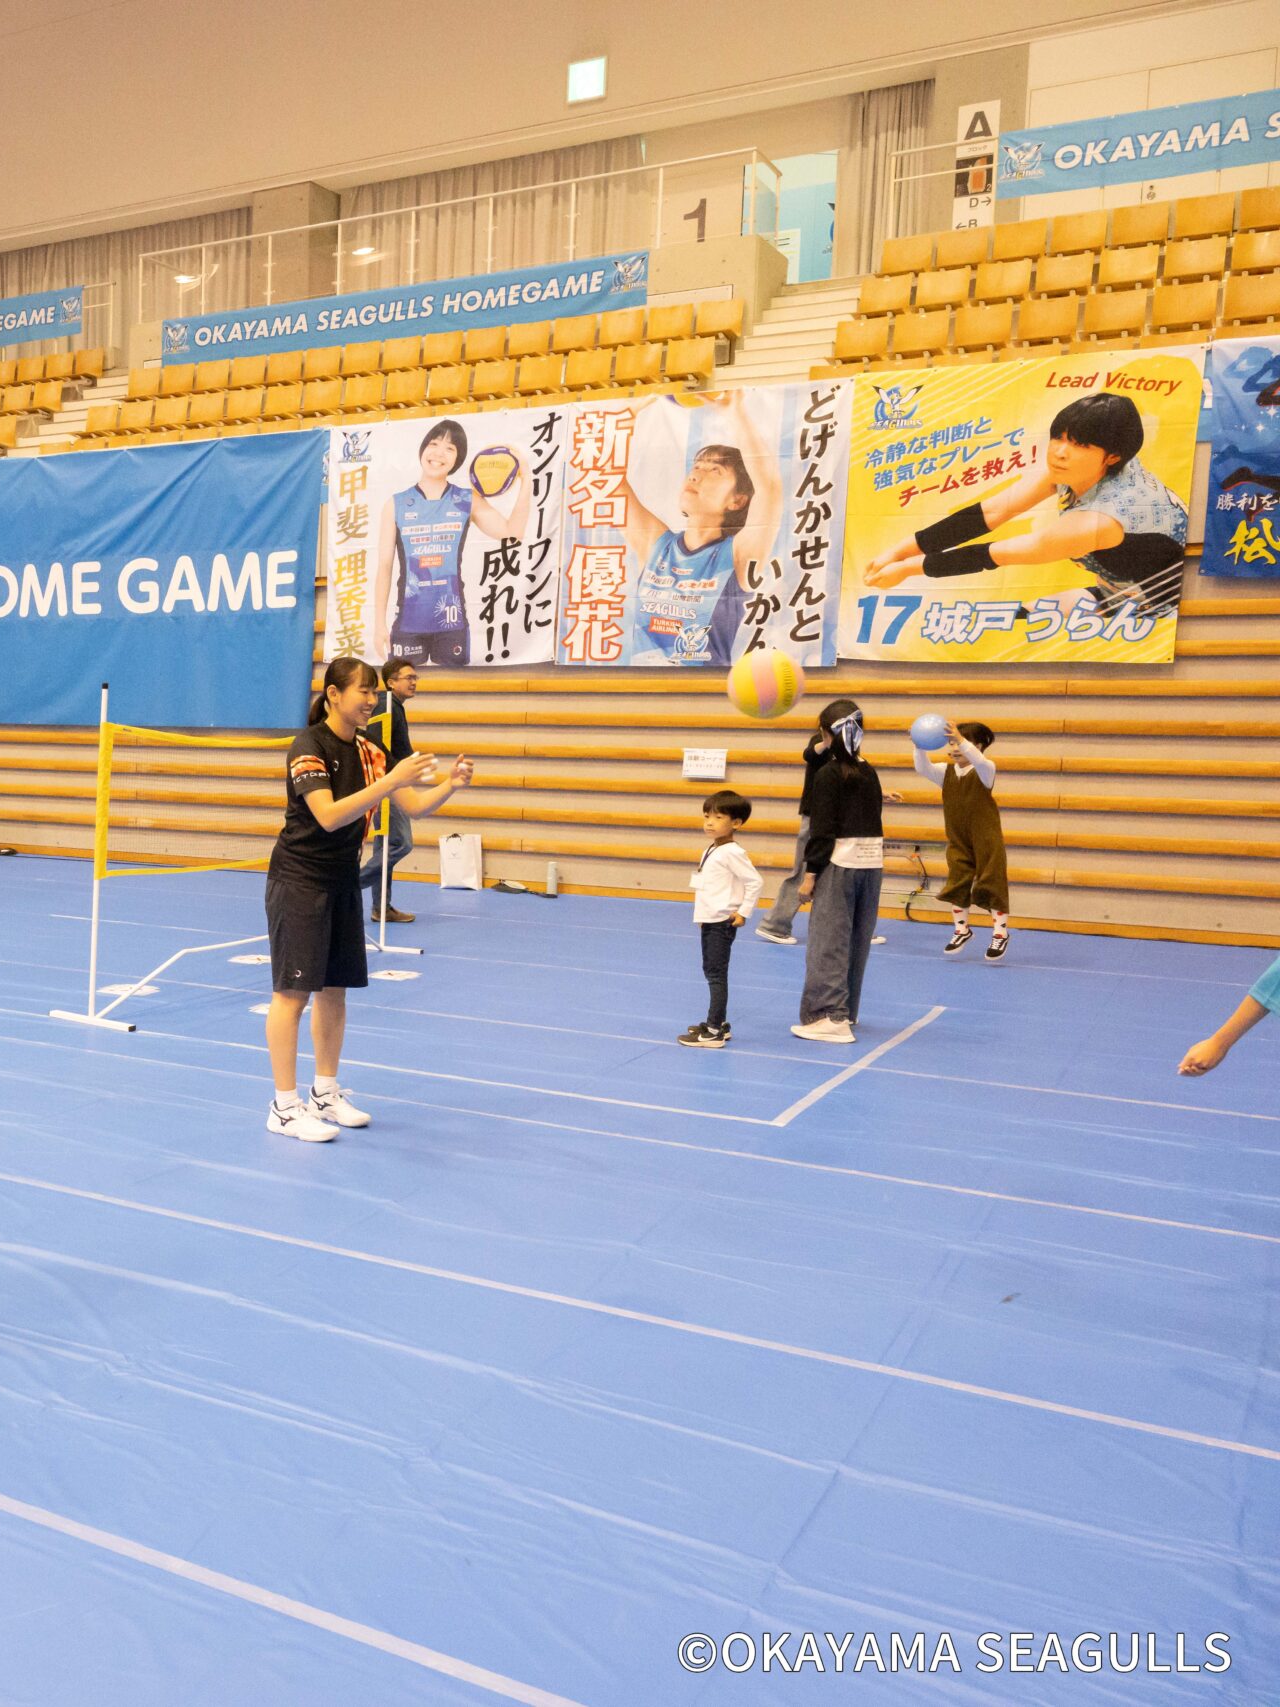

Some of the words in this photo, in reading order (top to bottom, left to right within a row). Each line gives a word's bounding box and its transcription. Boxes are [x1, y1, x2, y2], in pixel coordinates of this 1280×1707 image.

[964, 110, 993, 141] A
[1053, 116, 1251, 170] OKAYAMA
[682, 198, 707, 243] 1
[969, 197, 979, 208] D
[193, 313, 309, 347] OKAYAMA
[316, 295, 434, 333] SEAGULLS
[441, 270, 605, 315] HOMEGAME
[1045, 371, 1100, 389] Lead
[1104, 372, 1183, 397] Victory
[568, 407, 635, 530] 新名
[863, 415, 993, 471] 冷静な判断と
[873, 427, 1025, 492] 強気なプレーで
[524, 411, 563, 634] オンリーワンに
[788, 384, 842, 643] どげんかせんと
[117, 549, 298, 615] GAME
[562, 544, 627, 662] 優花
[444, 605, 458, 624] 10
[639, 602, 697, 620] SEAGULLS
[856, 595, 923, 646] 17
[921, 596, 1157, 645] 城戸うらん
[392, 643, 403, 657] 10
